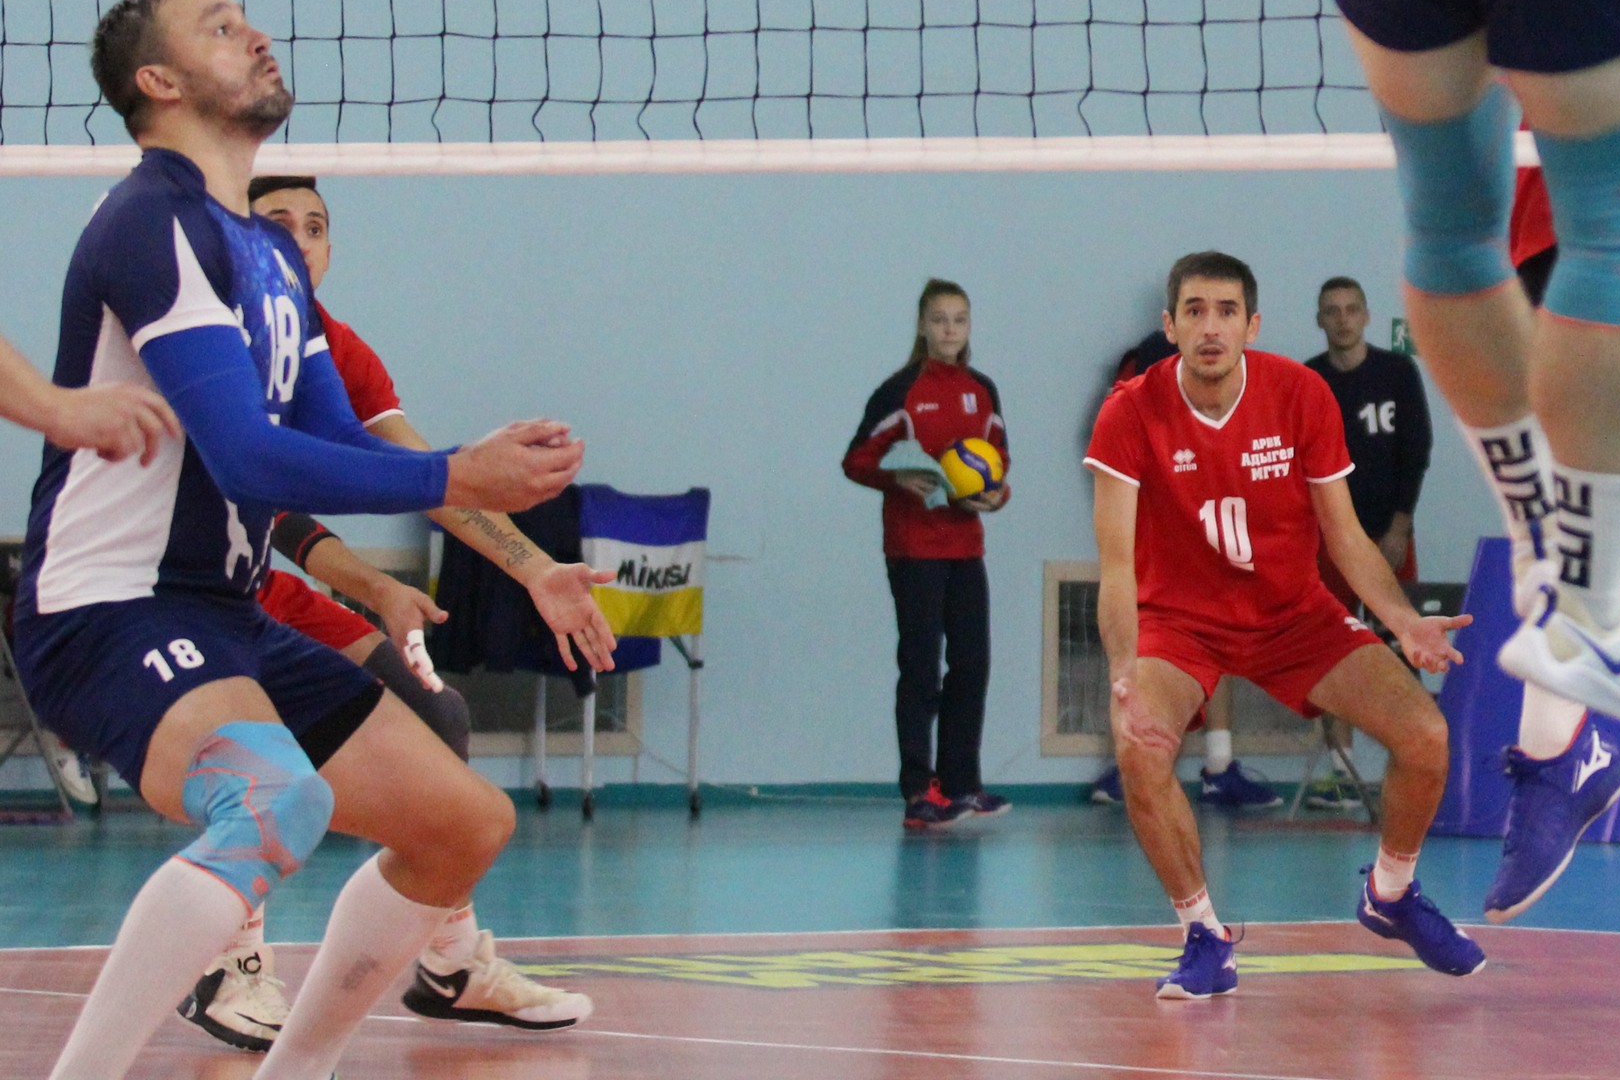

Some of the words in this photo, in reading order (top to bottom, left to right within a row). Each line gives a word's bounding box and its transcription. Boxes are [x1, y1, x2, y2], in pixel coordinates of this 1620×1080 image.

[263, 292, 301, 403] 18
[1241, 446, 1295, 467] Адыгея
[1250, 462, 1291, 482] МГТУ
[1199, 496, 1256, 571] 10
[142, 637, 206, 683] 18
